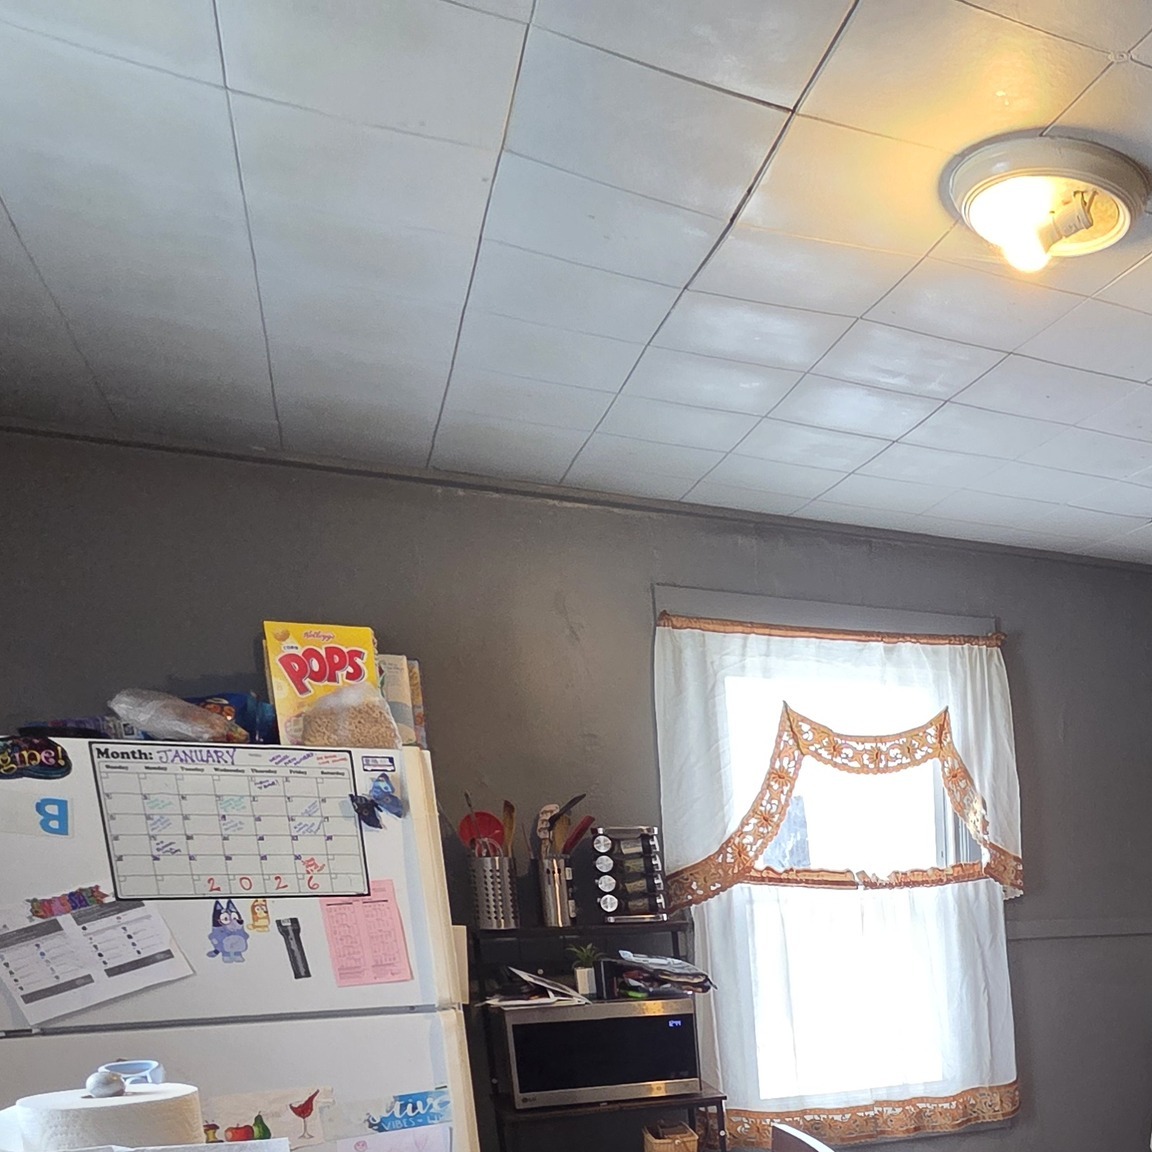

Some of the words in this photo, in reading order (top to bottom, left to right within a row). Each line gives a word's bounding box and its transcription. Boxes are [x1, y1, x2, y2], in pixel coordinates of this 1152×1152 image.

[277, 645, 368, 697] POPS
[96, 747, 153, 760] Month:
[156, 748, 236, 765] JANUARY
[35, 798, 69, 836] B
[381, 1115, 416, 1131] VIBES
